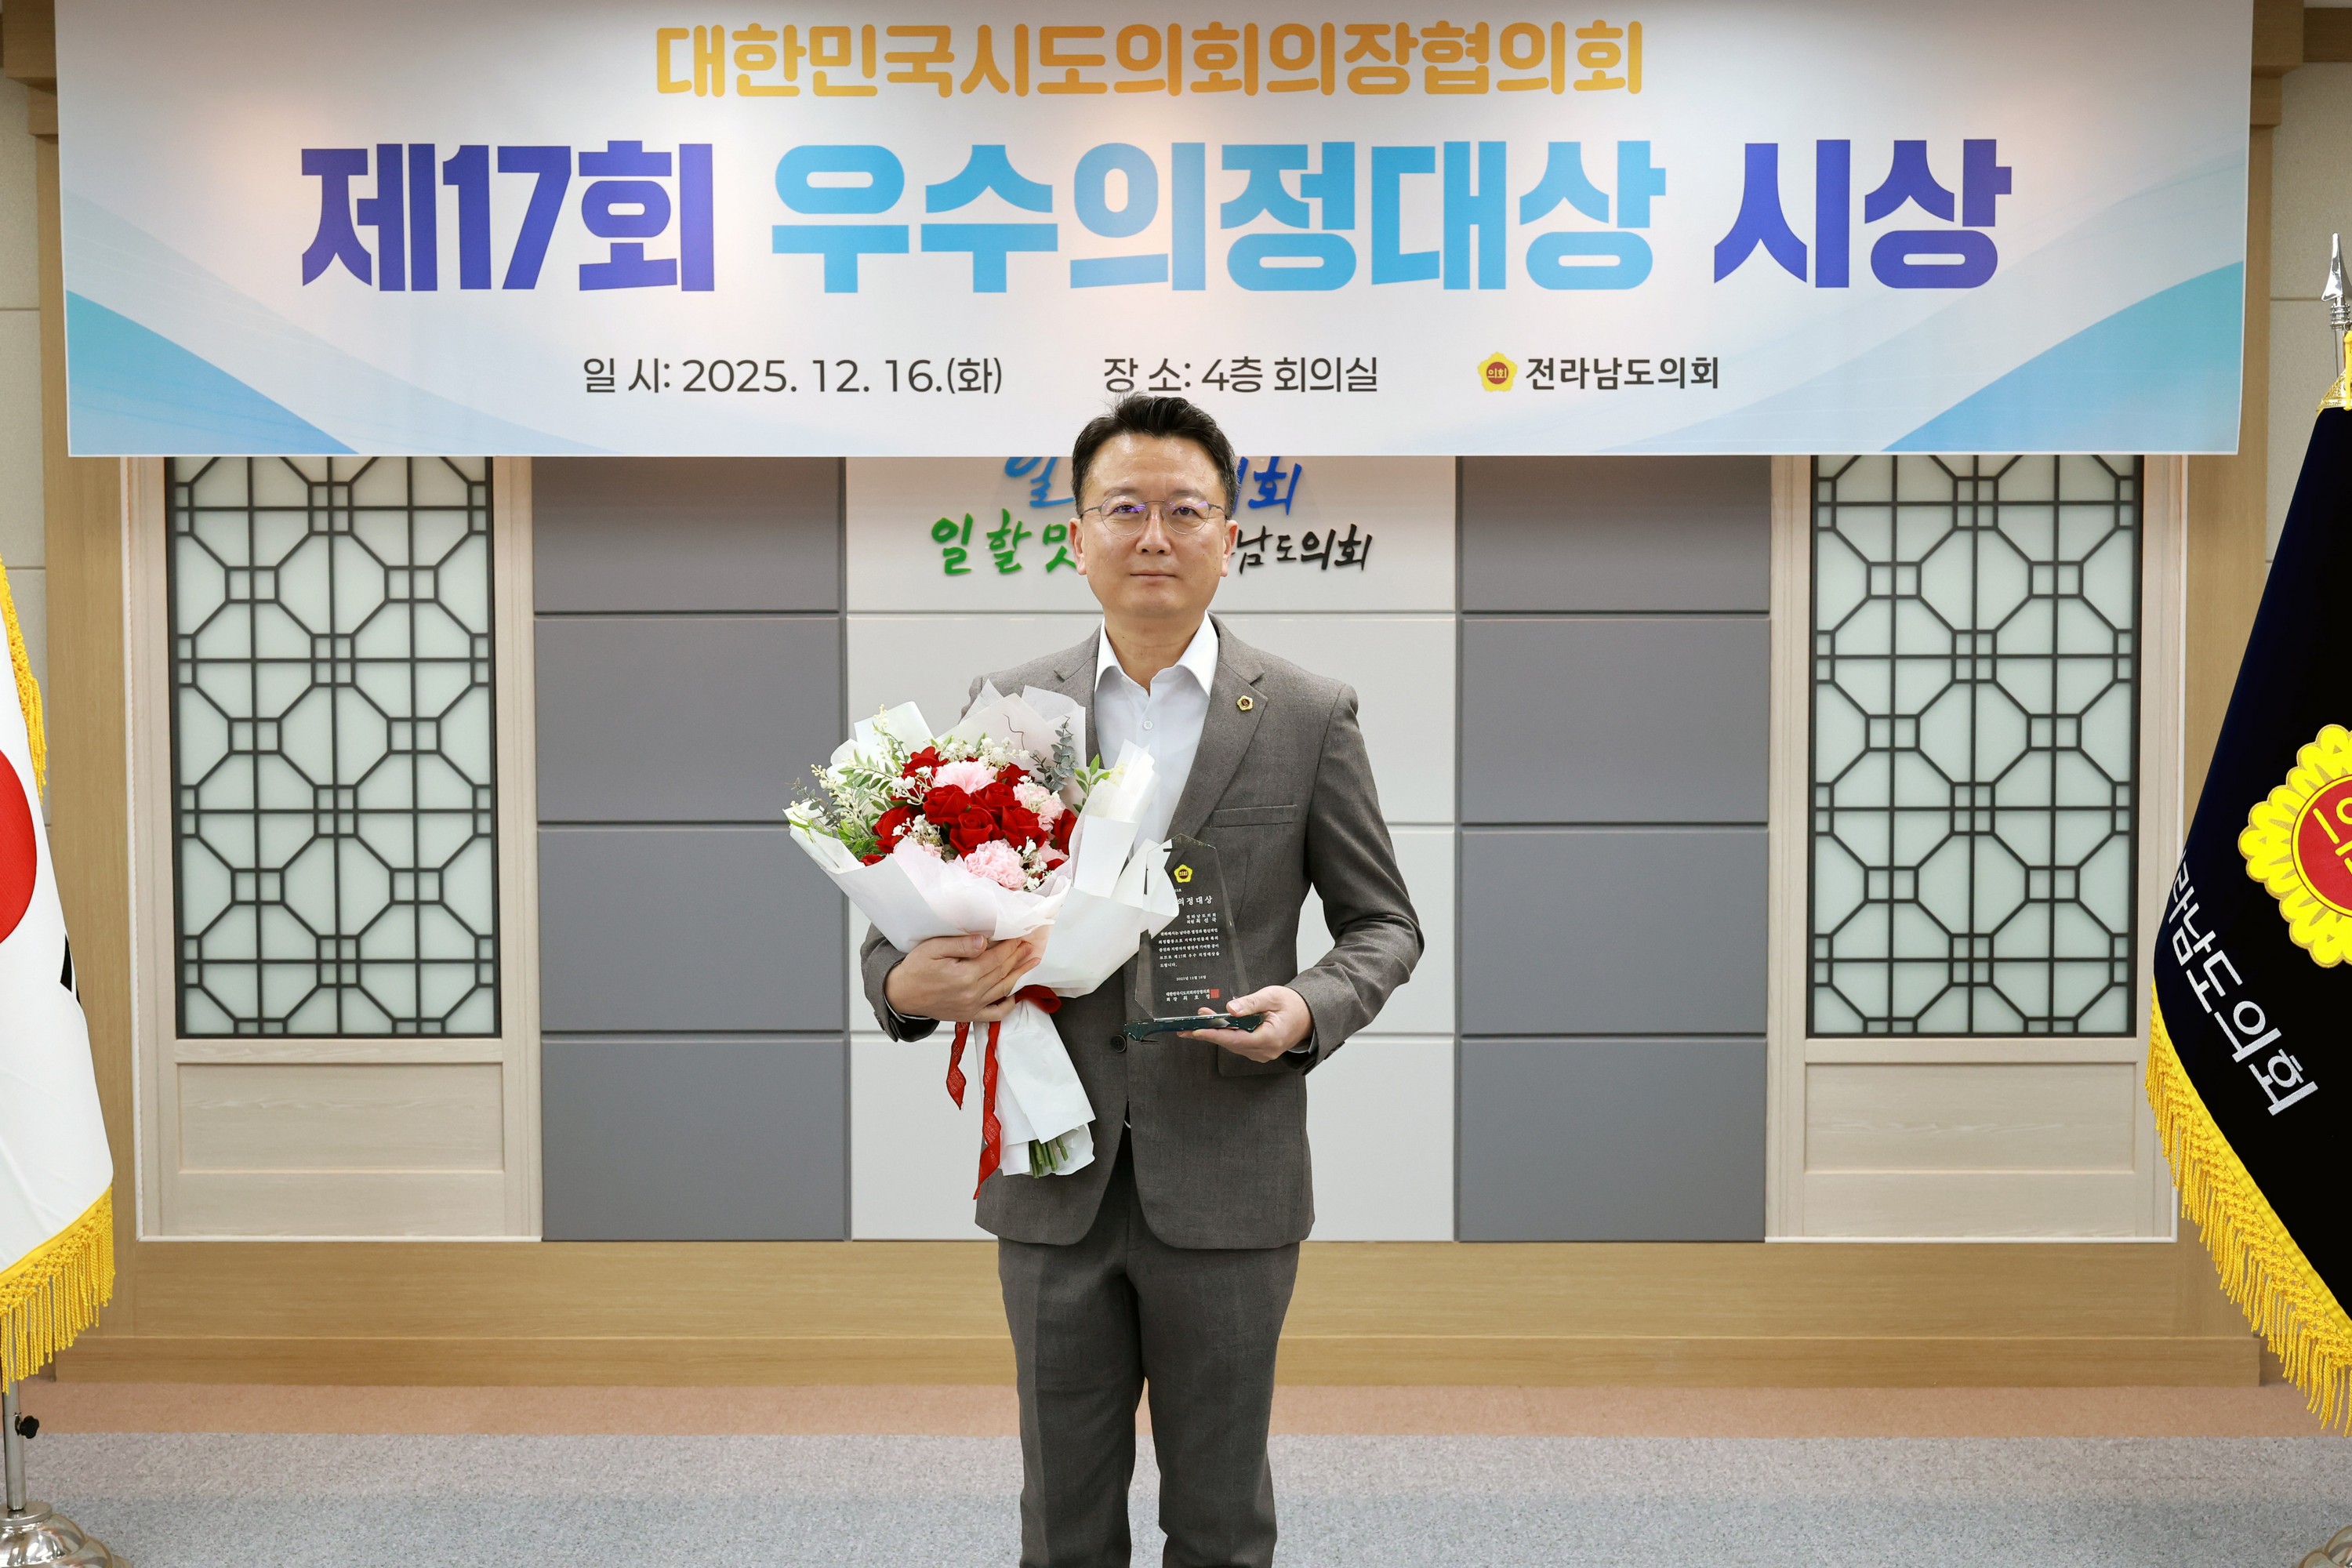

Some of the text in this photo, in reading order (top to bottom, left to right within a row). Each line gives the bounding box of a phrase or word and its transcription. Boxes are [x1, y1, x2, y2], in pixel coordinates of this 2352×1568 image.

[656, 19, 1643, 99] 대한민국시도의회의장협의회
[302, 140, 2013, 293] 제17회 우수의정대상 시상
[682, 359, 797, 393] 2025.
[812, 360, 869, 392] 12.
[1202, 356, 1263, 393] 4층
[1274, 357, 1377, 393] 회의실
[1526, 357, 1719, 390] 전라남도의회
[1231, 524, 1373, 575] 남도의회
[2169, 849, 2318, 1116] 라남도의회
